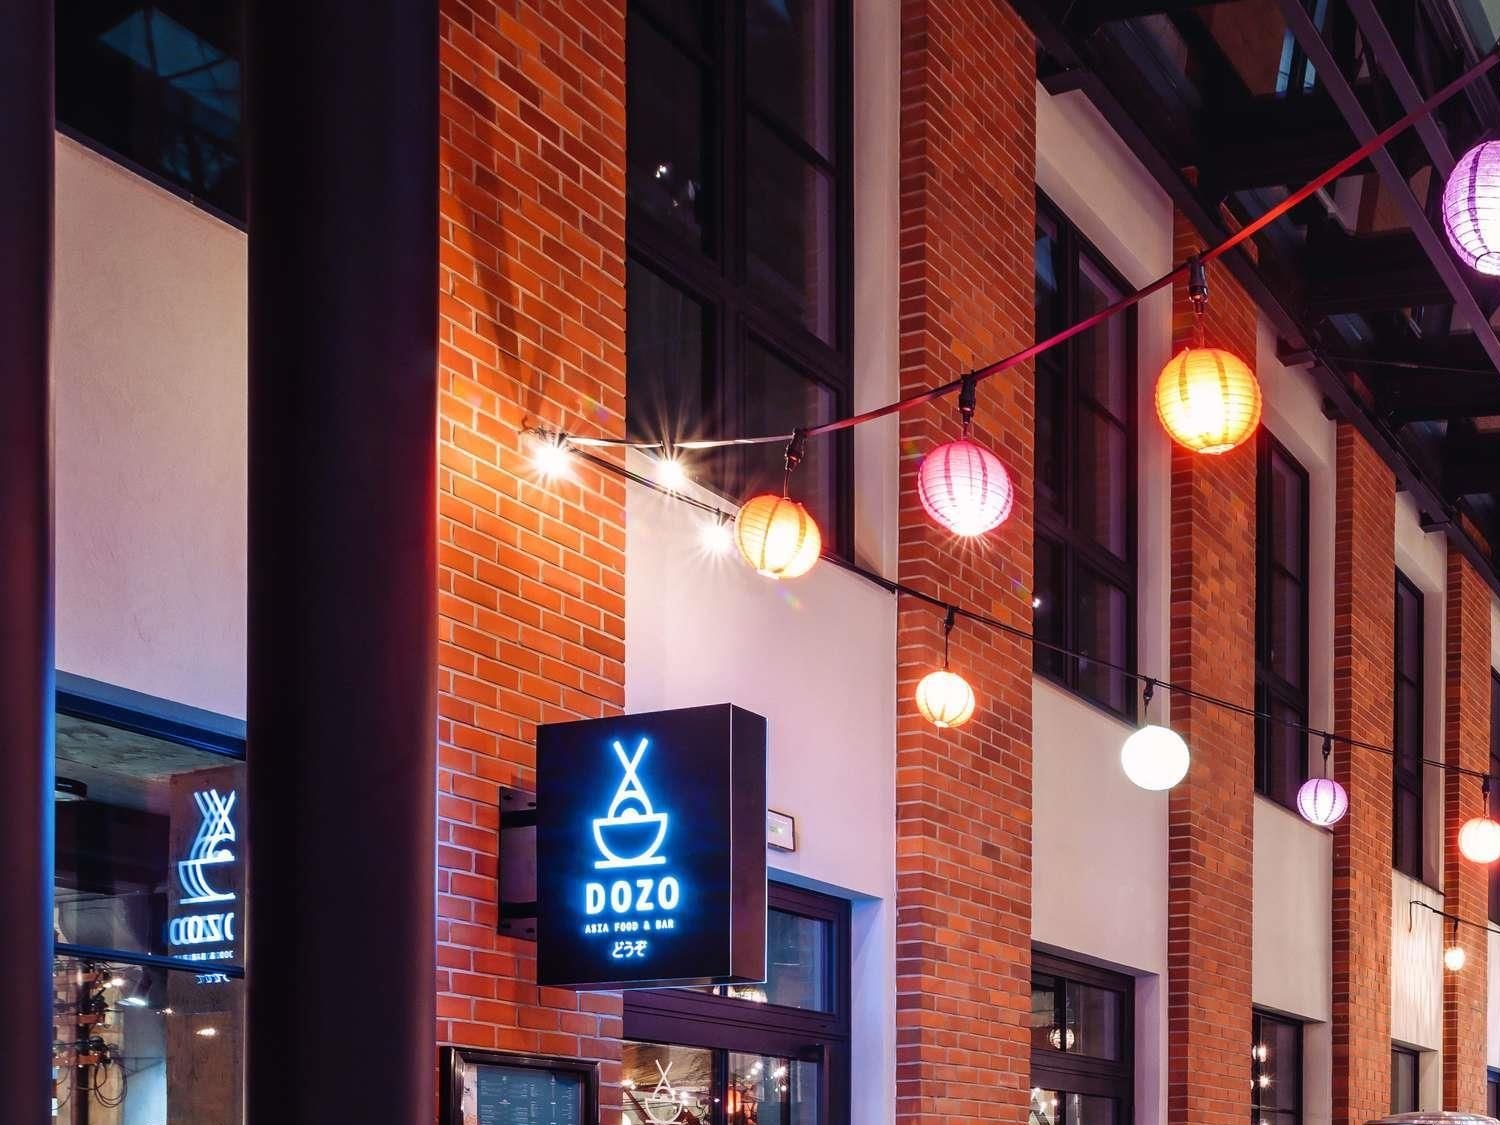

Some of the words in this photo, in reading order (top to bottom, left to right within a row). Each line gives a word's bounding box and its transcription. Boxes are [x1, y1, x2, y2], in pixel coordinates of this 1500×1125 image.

[585, 876, 680, 915] DOZO
[584, 922, 609, 934] ASIA
[613, 921, 639, 932] FOOD
[643, 920, 651, 931] &
[655, 918, 675, 930] BAR
[611, 940, 648, 959] どうぞ
